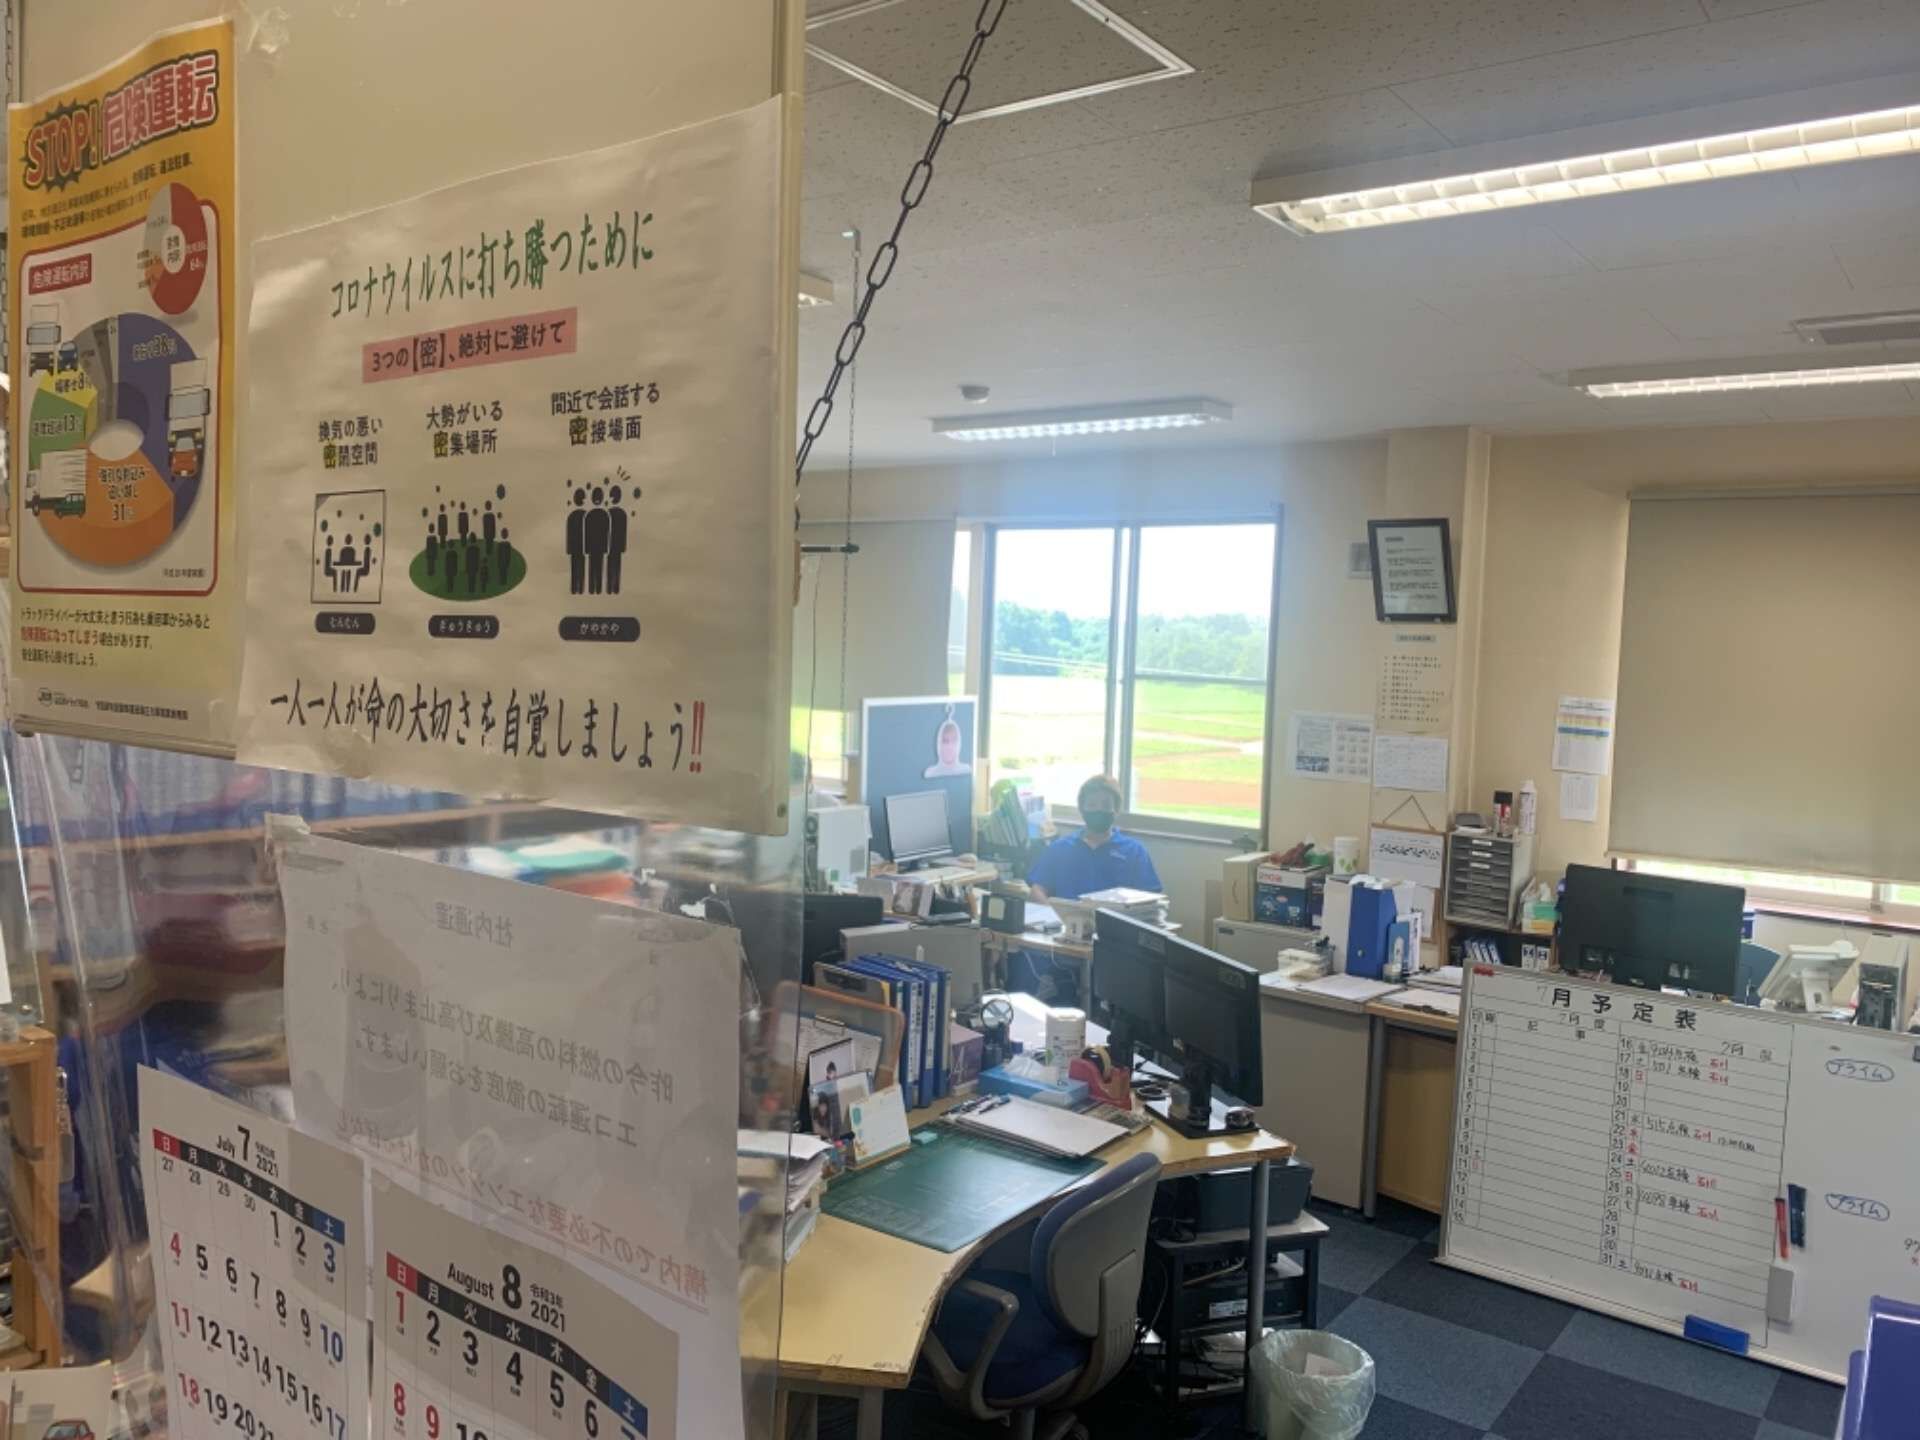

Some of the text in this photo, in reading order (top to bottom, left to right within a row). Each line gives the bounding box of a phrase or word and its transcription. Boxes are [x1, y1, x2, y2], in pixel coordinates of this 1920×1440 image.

[330, 211, 654, 318] コロナウイルスに打ち勝つために
[426, 401, 503, 431] 大勢がいる
[551, 383, 660, 416] 間近で会話する
[318, 416, 383, 443] 換気の悪い
[433, 429, 498, 458] 密集場所
[569, 415, 642, 448] 密接場面
[323, 442, 378, 470] 密閉空間
[217, 1135, 235, 1158] July
[238, 1125, 250, 1161] 7
[256, 1155, 279, 1178] 2021
[162, 1157, 175, 1173] 27
[189, 1169, 201, 1185] 28
[217, 1181, 231, 1197] 29
[270, 1211, 279, 1239] 1
[295, 1226, 307, 1257] 2
[323, 1242, 336, 1273] 3
[170, 1232, 343, 1363] 4 5 6 7 8 9 10
[447, 1262, 494, 1301] August
[502, 1264, 522, 1310] 8
[530, 1300, 565, 1333] 2021
[397, 1263, 407, 1283] 日
[428, 1283, 439, 1304] 月
[464, 1302, 478, 1324] 火
[505, 1320, 520, 1341] 水
[550, 1342, 563, 1362] 木
[623, 1398, 635, 1419] 土
[171, 1302, 346, 1440] 11 12 13 14 15 16 17
[396, 1290, 404, 1324] 1
[427, 1310, 440, 1347] 2
[463, 1330, 478, 1366] 3
[506, 1352, 523, 1386] 4
[550, 1370, 564, 1409] 5
[584, 1399, 599, 1439] 6
[178, 1372, 200, 1404] 18
[204, 1388, 228, 1420] 19
[233, 1403, 256, 1438] 20
[393, 1382, 406, 1417] 8
[426, 1404, 440, 1439] 9
